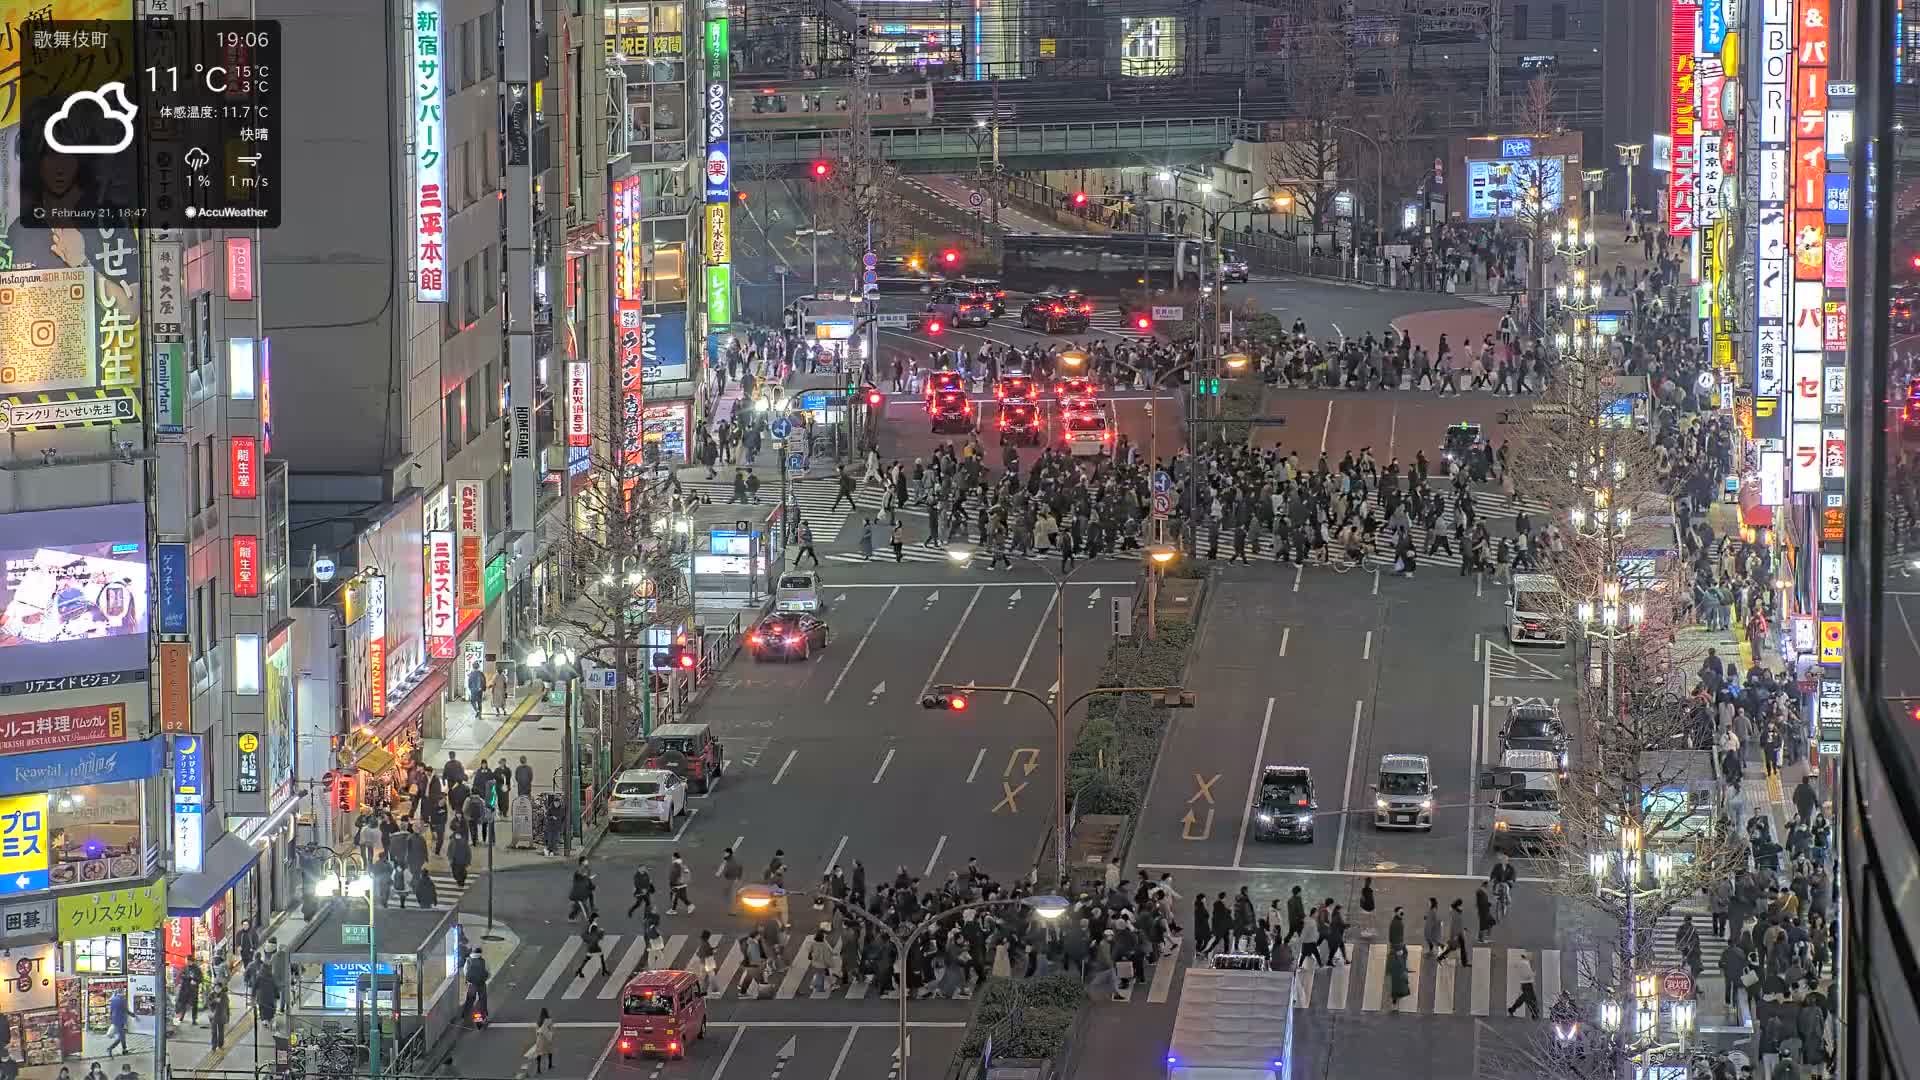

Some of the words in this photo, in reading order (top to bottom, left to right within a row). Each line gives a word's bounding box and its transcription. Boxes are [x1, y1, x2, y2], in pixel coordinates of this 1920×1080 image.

[417, 11, 440, 168] 新宿サンパーク
[420, 184, 442, 290] 三平本館
[711, 276, 725, 313] レイク
[159, 323, 177, 334] 3F
[1761, 330, 1774, 381] 大衆酒場
[158, 352, 170, 414] FamilyMart
[55, 403, 113, 418] たいせい先生
[1829, 496, 1840, 505] 3F
[434, 542, 451, 628] 三平ストア
[25, 676, 77, 693] リアエイド
[80, 672, 121, 687] ビジョン
[26, 734, 71, 747] RESTAURANT
[3, 810, 41, 834] プロ
[3, 836, 41, 858] ミス
[6, 912, 40, 930] 囲碁
[72, 902, 144, 927] クリスタル
